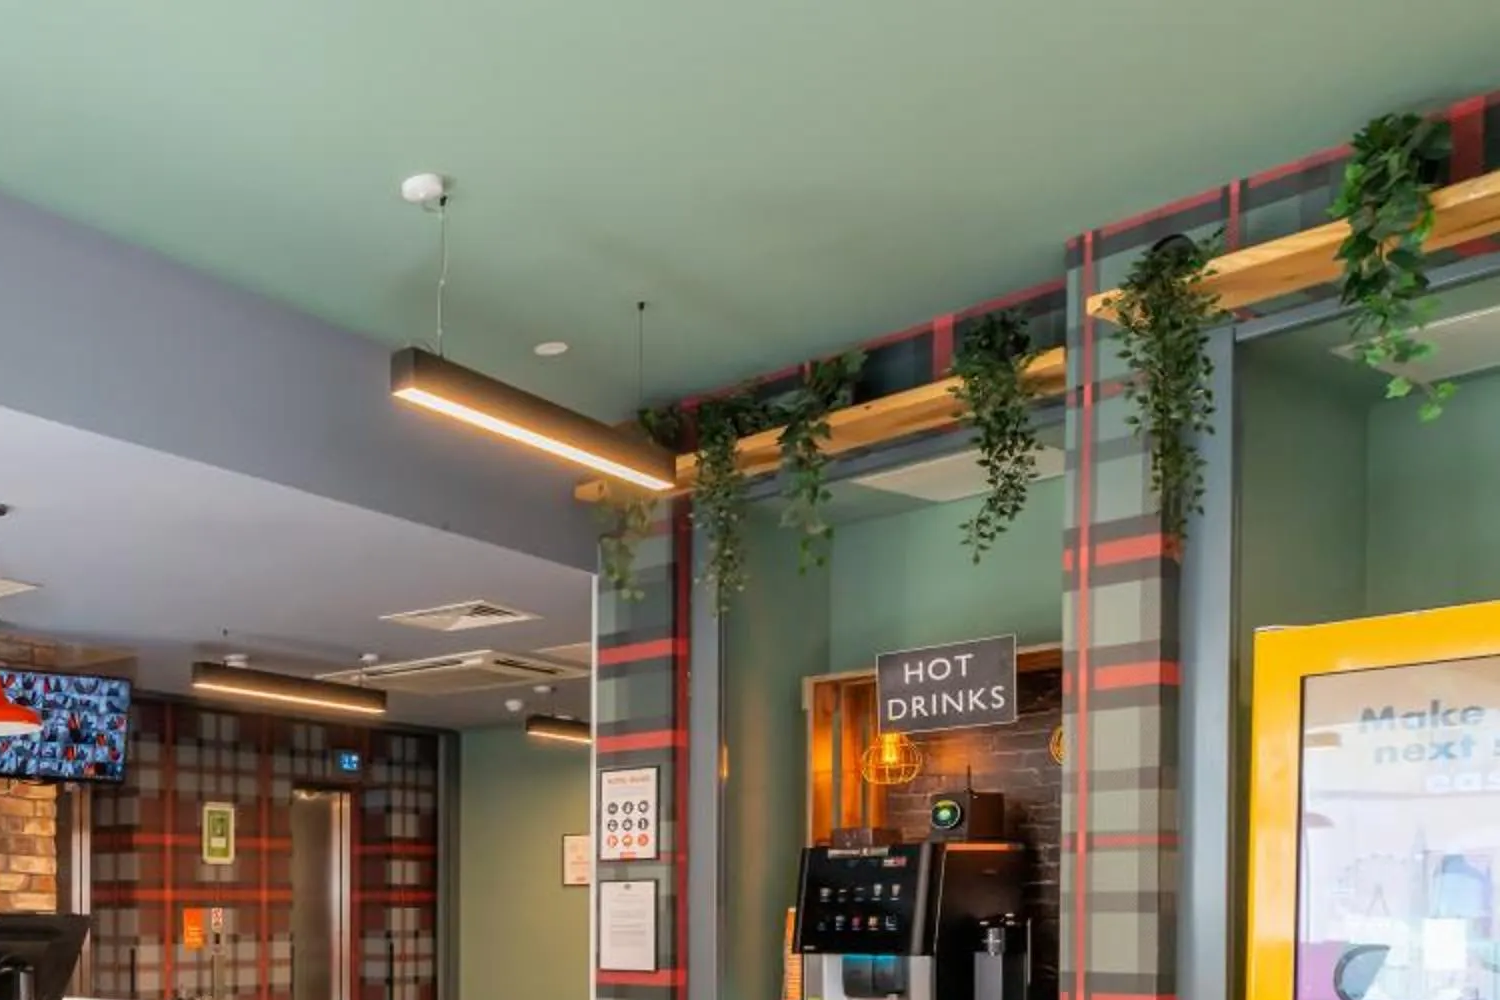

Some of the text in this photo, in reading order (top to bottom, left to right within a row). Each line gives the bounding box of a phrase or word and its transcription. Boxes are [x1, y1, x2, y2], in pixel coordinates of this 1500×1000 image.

[903, 653, 975, 685] HOT
[887, 685, 1006, 721] DRINKS
[1358, 699, 1486, 734] Make
[1374, 733, 1476, 765] next
